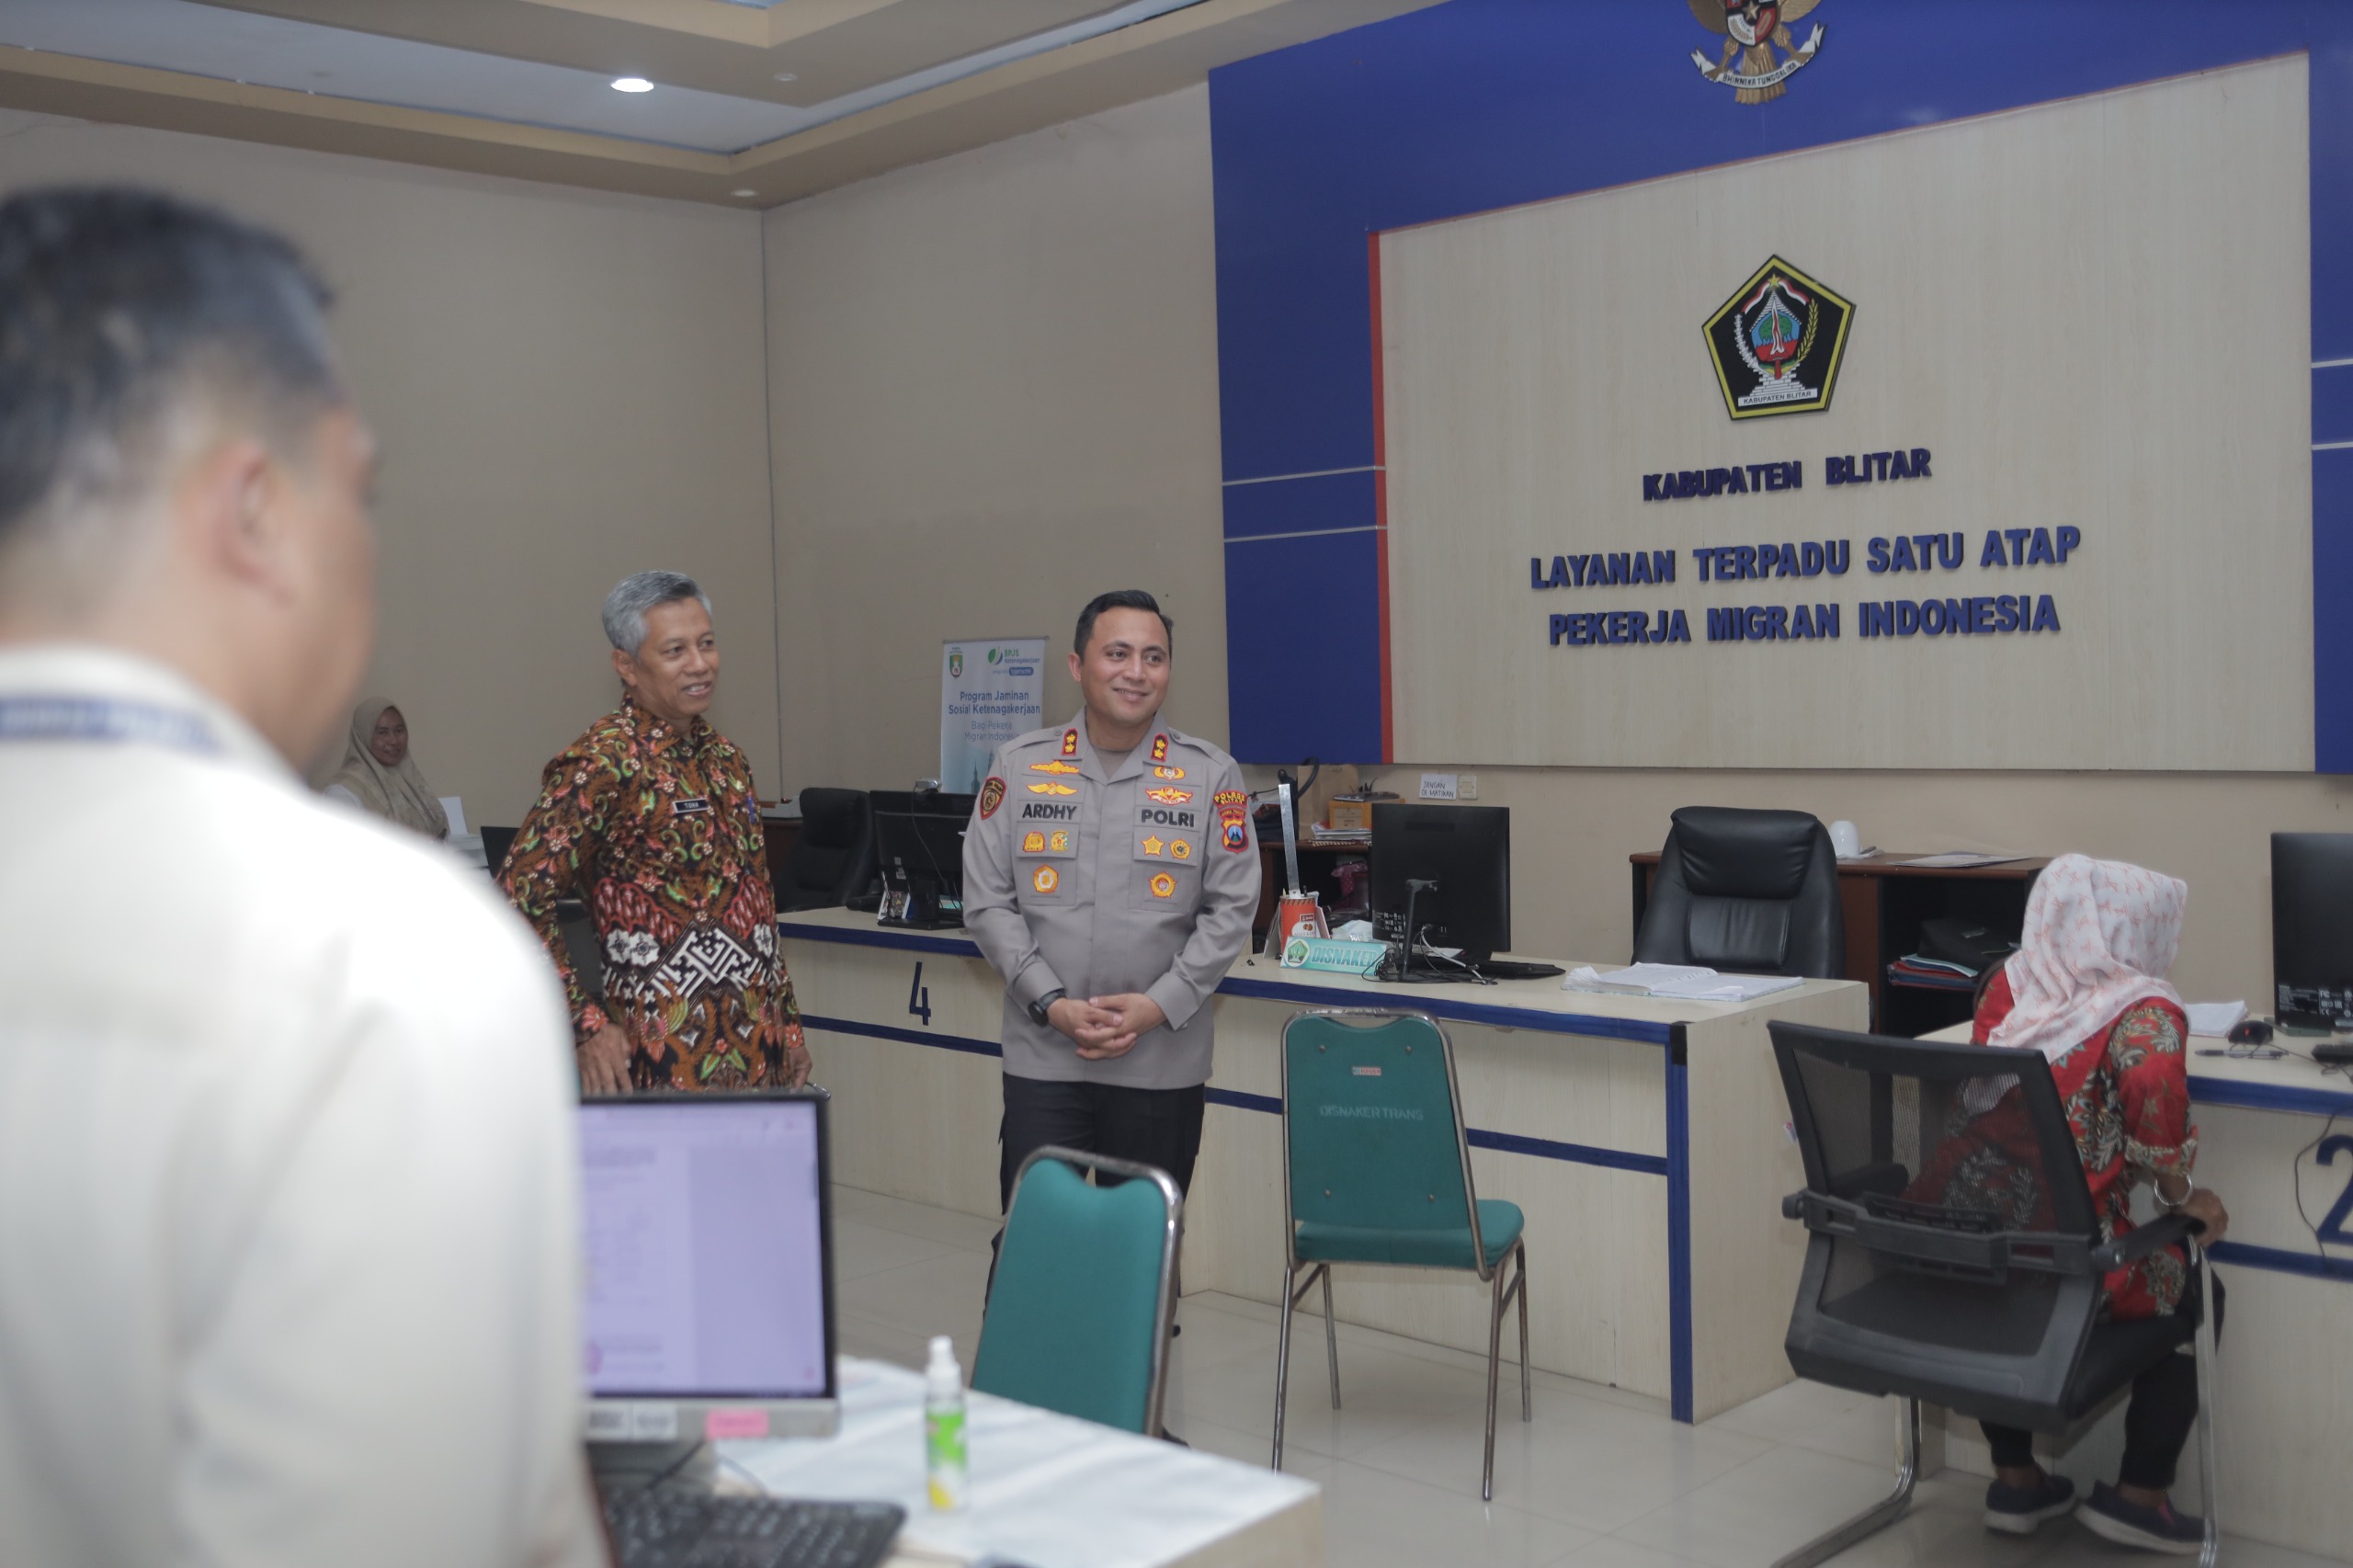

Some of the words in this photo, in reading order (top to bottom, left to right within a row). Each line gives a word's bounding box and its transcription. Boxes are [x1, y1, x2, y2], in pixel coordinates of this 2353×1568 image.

[1744, 395, 1785, 404] KABUPATEN
[1786, 391, 1812, 400] BLITAR
[1643, 460, 1802, 501] KABUPATEN
[1825, 448, 1932, 485] BLITAR
[1531, 550, 1676, 589] LAYANAN
[1693, 540, 1850, 582] TERPADU
[1867, 532, 1964, 573] SATU
[1980, 526, 2081, 567] ATAP
[1550, 609, 1692, 645] PEKERJA
[1707, 603, 1840, 642] MIGRAN
[1859, 594, 2061, 638] INDONESIA
[960, 691, 993, 702] Program
[995, 690, 1029, 700] Jaminan
[949, 704, 971, 714] Sosial
[972, 703, 1040, 715] Ketenagakerjaan
[1424, 781, 1446, 790] JANGAN
[1429, 790, 1454, 799] MATIKAN
[1022, 803, 1077, 820] ARDHY
[1141, 809, 1195, 827] POLRI
[909, 961, 931, 1026] 4
[1382, 1108, 1424, 1120] TRANS
[2315, 1134, 2353, 1245] 2
